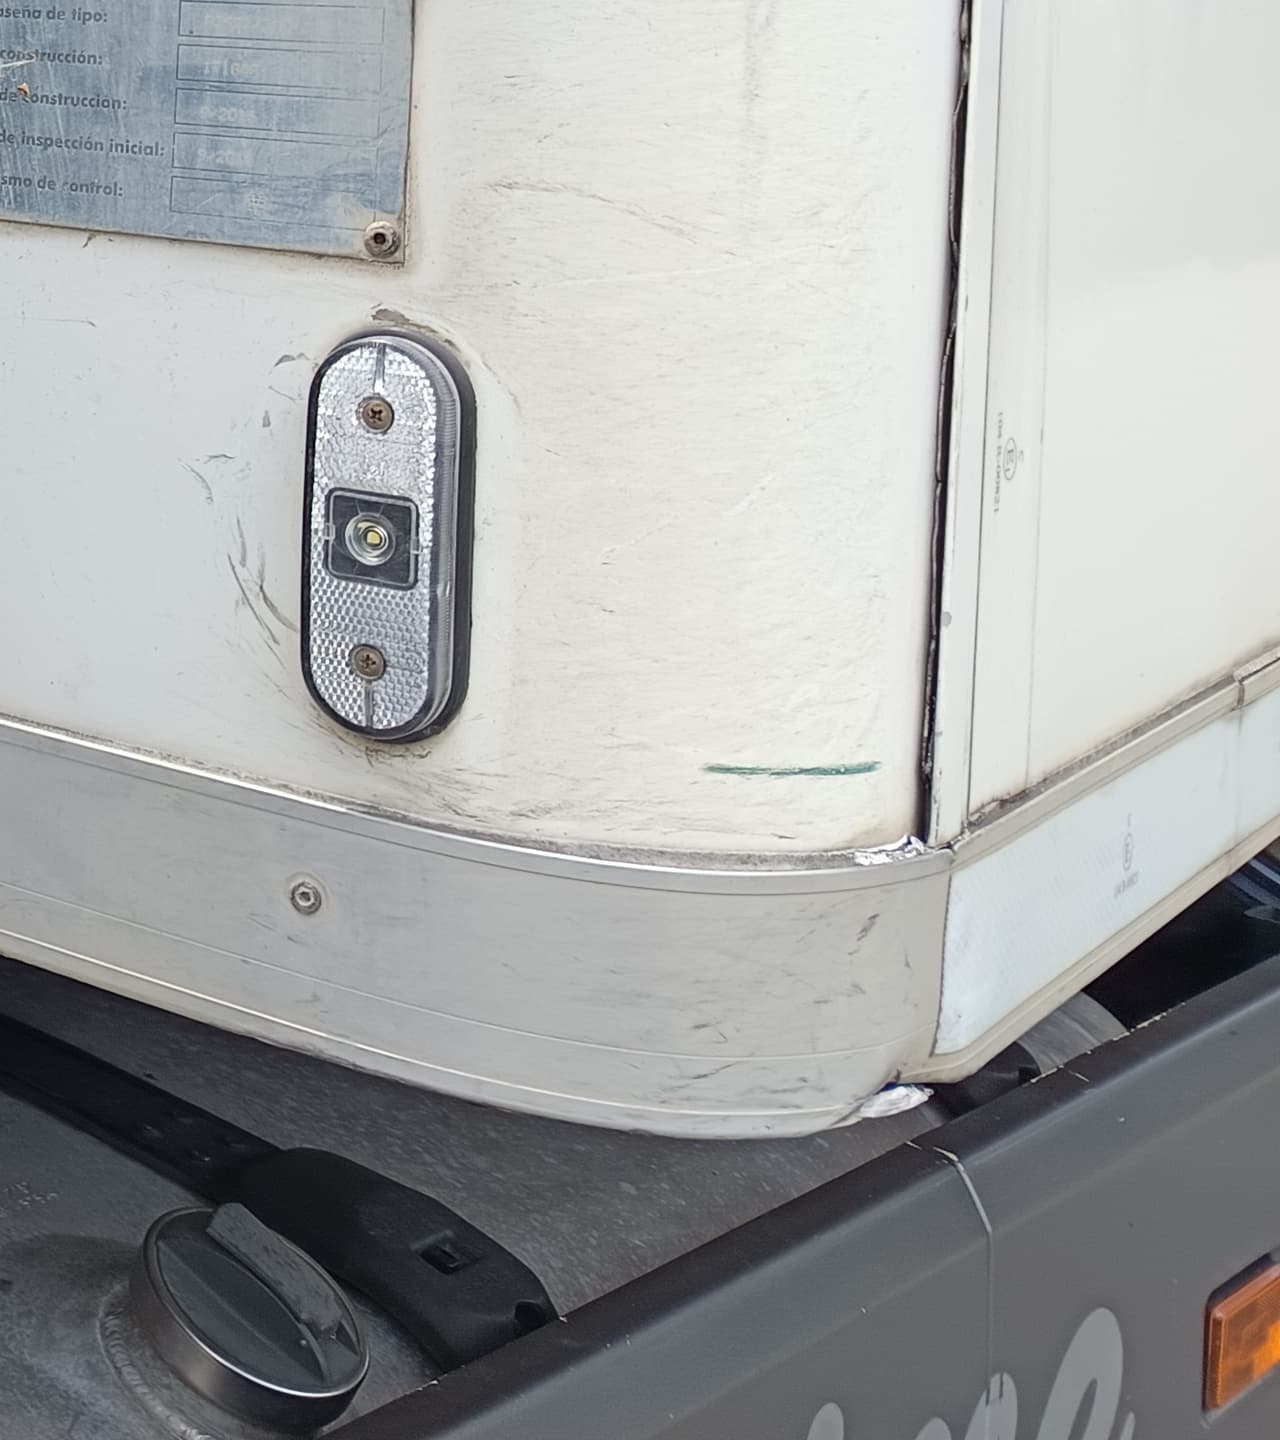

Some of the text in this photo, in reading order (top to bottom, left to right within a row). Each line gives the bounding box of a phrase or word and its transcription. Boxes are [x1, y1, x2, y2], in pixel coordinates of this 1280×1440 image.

[46, 5, 66, 21] de
[71, 7, 108, 25] tipo:
[0, 48, 103, 65] construcción:
[21, 131, 104, 152] inspección
[108, 138, 166, 157] inicial:
[36, 175, 56, 190] de
